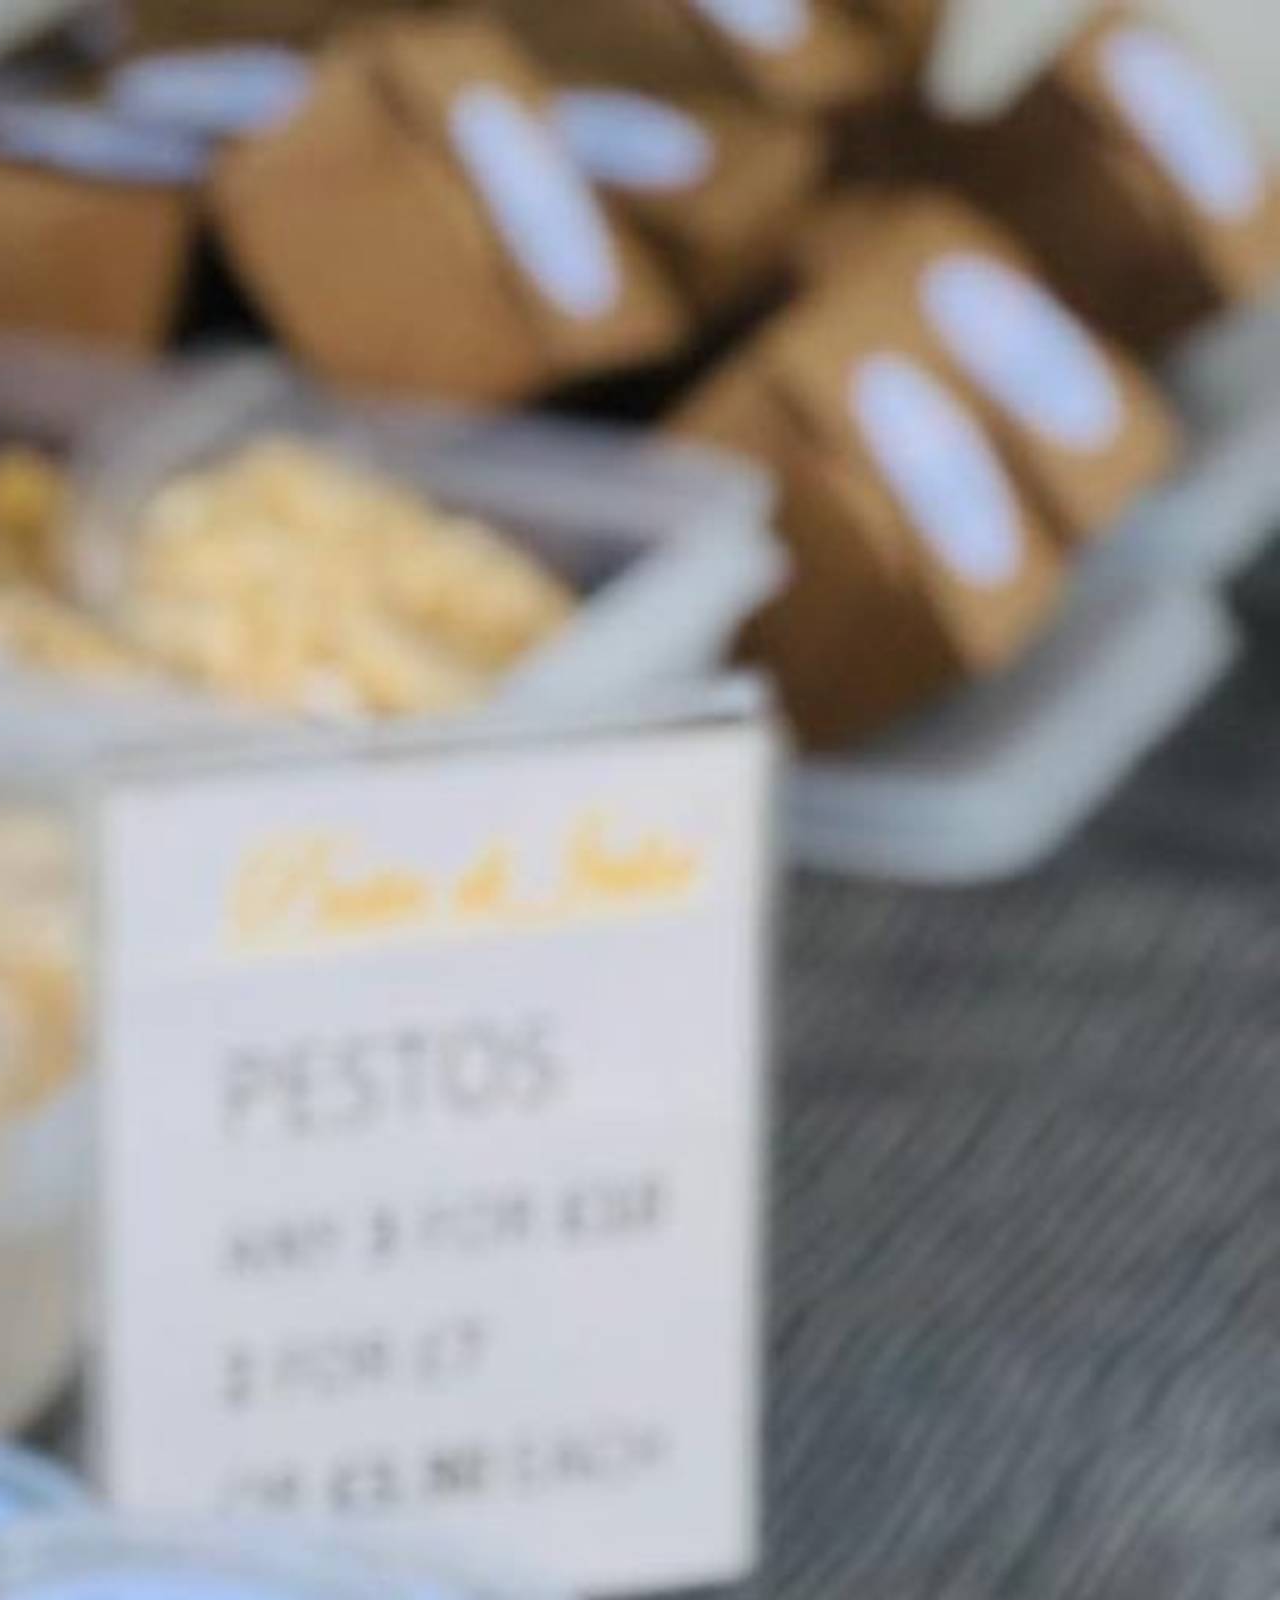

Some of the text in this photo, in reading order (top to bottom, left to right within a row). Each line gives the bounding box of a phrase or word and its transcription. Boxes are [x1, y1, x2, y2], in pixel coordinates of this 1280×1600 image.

[222, 1014, 566, 1138] PESTOS
[416, 1186, 530, 1252] FOR
[272, 1326, 390, 1396] FOR
